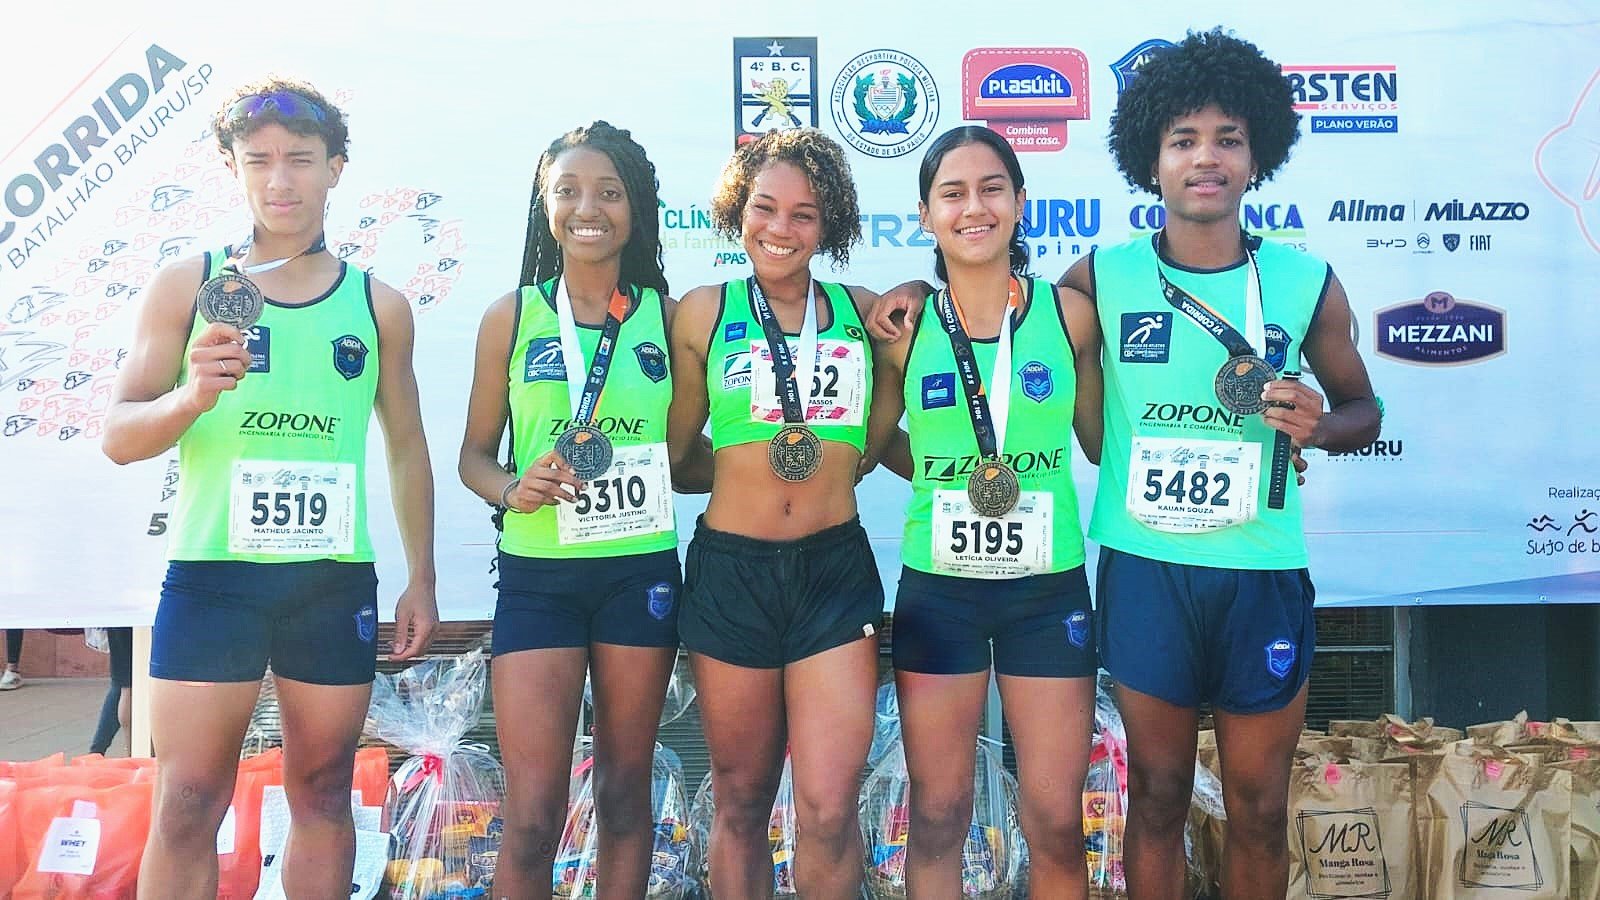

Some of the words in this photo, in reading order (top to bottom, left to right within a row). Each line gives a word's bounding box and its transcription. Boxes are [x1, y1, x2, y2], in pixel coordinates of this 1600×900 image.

[856, 52, 898, 67] DESPORTIVA
[1287, 72, 1397, 102] RSTEN
[1006, 125, 1049, 136] Combina
[1315, 119, 1354, 129] PLANO
[1355, 118, 1394, 129] VERÃO
[1016, 137, 1034, 145] sua
[1036, 137, 1060, 145] casa.
[7, 162, 114, 270] BATALHÃO
[113, 62, 213, 166] BAURU/SP
[664, 204, 712, 229] CLÍN
[1022, 198, 1100, 238] URU
[1327, 199, 1406, 222] Allma
[1366, 239, 1407, 248] BYD
[1470, 234, 1491, 251] FIAT
[714, 252, 747, 267] APAS
[1181, 300, 1215, 329] CORRIDA
[1212, 325, 1224, 336] VI
[1388, 324, 1493, 343] MEZZANI
[1415, 345, 1468, 356] ALIMENTOS
[239, 411, 337, 434] ZOPONE
[1141, 402, 1245, 428] ZOPONE
[549, 416, 646, 436] ZONE
[575, 475, 646, 515] 5310
[1143, 469, 1231, 507] 5482
[250, 491, 328, 527] 5519
[577, 513, 617, 523] VICTTORIA
[618, 509, 647, 518] JUSTINO
[1157, 505, 1186, 513] KAUAN
[1187, 506, 1214, 514] SOUZA
[292, 527, 324, 535] JACINTO
[950, 520, 1024, 556] 5195
[1526, 538, 1564, 556] Sujo
[1568, 538, 1587, 554] de
[955, 555, 983, 563] LETÍCIA
[1319, 859, 1351, 868] Manga
